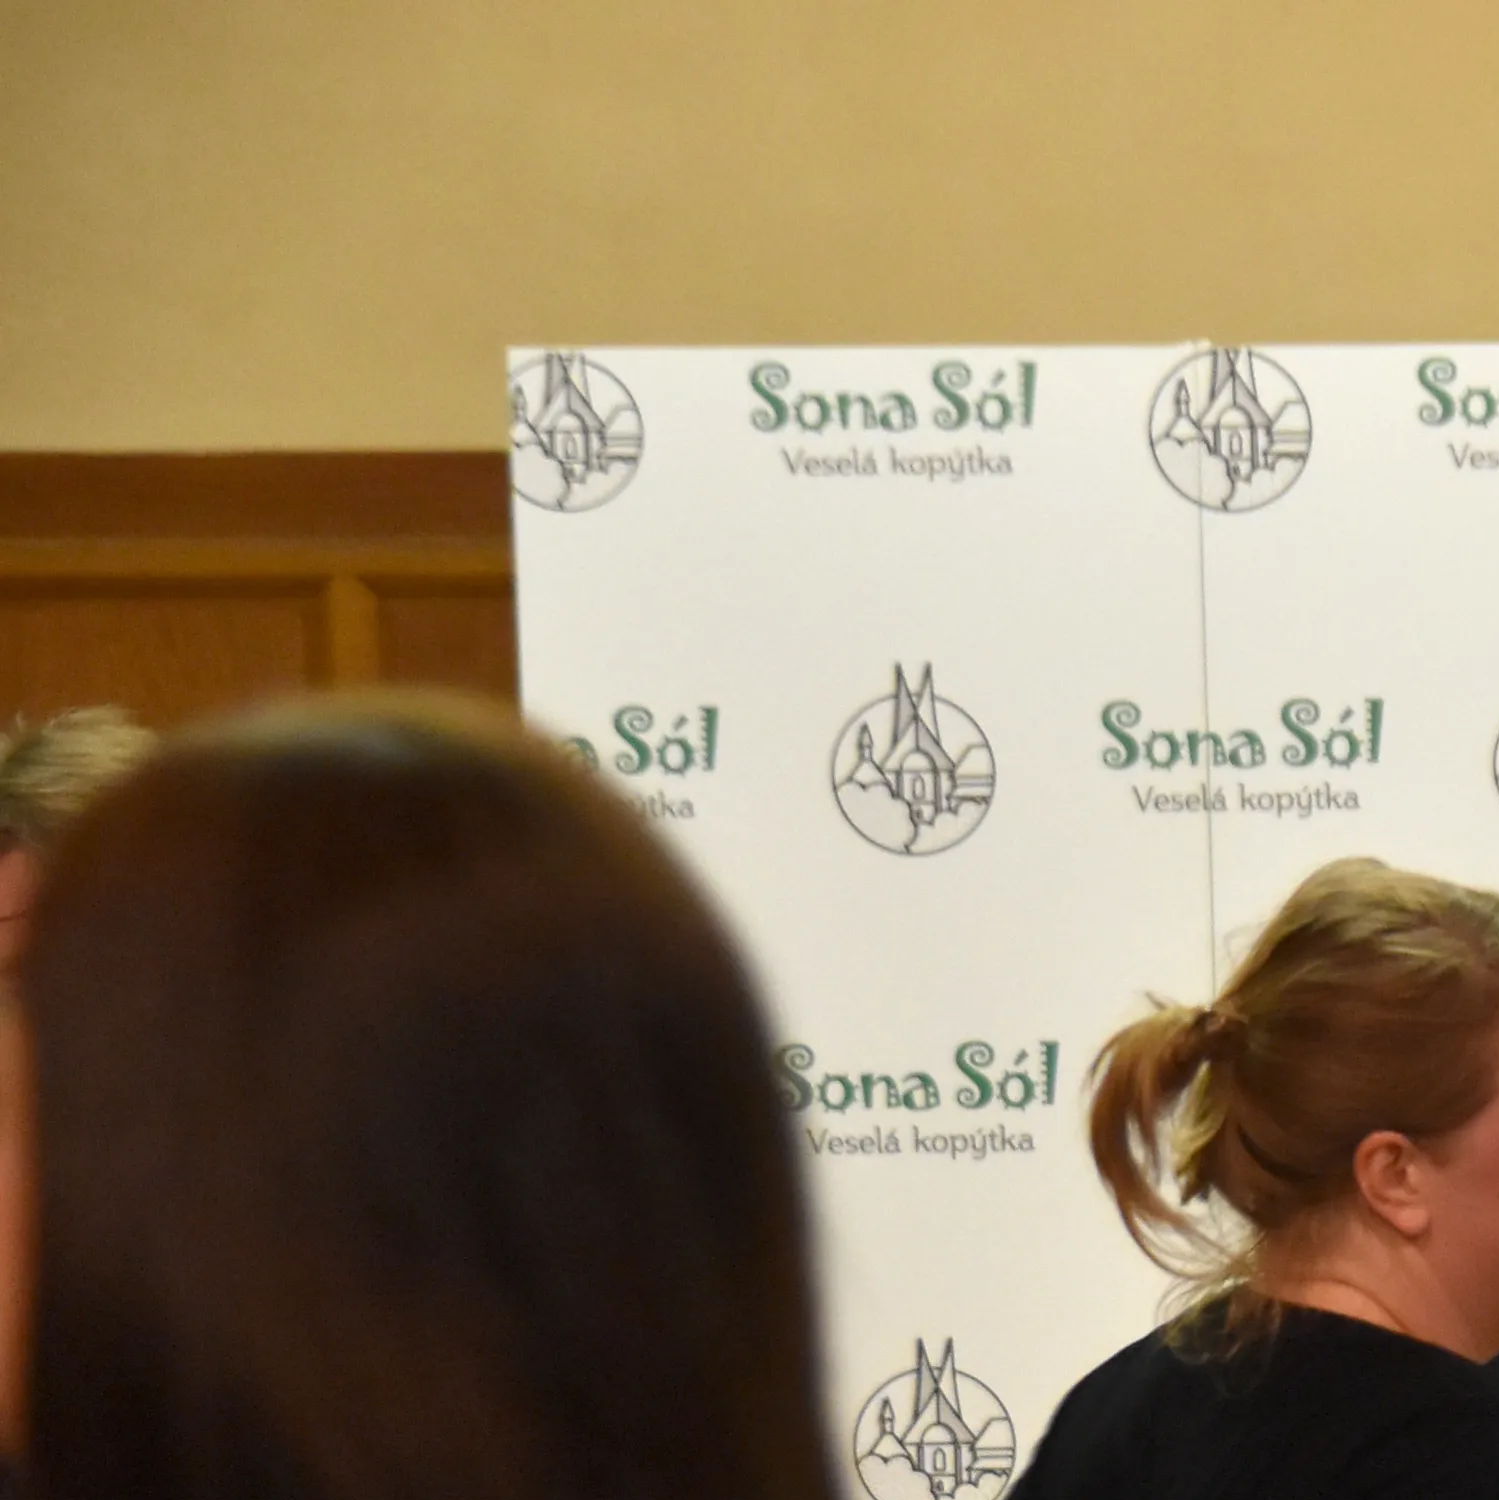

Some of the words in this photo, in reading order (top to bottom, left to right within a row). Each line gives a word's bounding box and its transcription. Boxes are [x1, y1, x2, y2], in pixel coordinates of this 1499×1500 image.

[748, 361, 917, 433] Sona
[932, 360, 1038, 432] Sól
[781, 446, 877, 478] Veselá
[891, 447, 1013, 484] kopýtka
[613, 705, 720, 778] Sól
[1101, 700, 1267, 770] Sona
[1280, 697, 1385, 769] Sól
[1132, 782, 1227, 813] Veselá
[1240, 782, 1360, 818] kopýtka
[778, 1043, 940, 1113] Sona
[954, 1040, 1060, 1111] Sól
[807, 1126, 900, 1155] Veselá
[913, 1125, 1035, 1160] kopýtka
